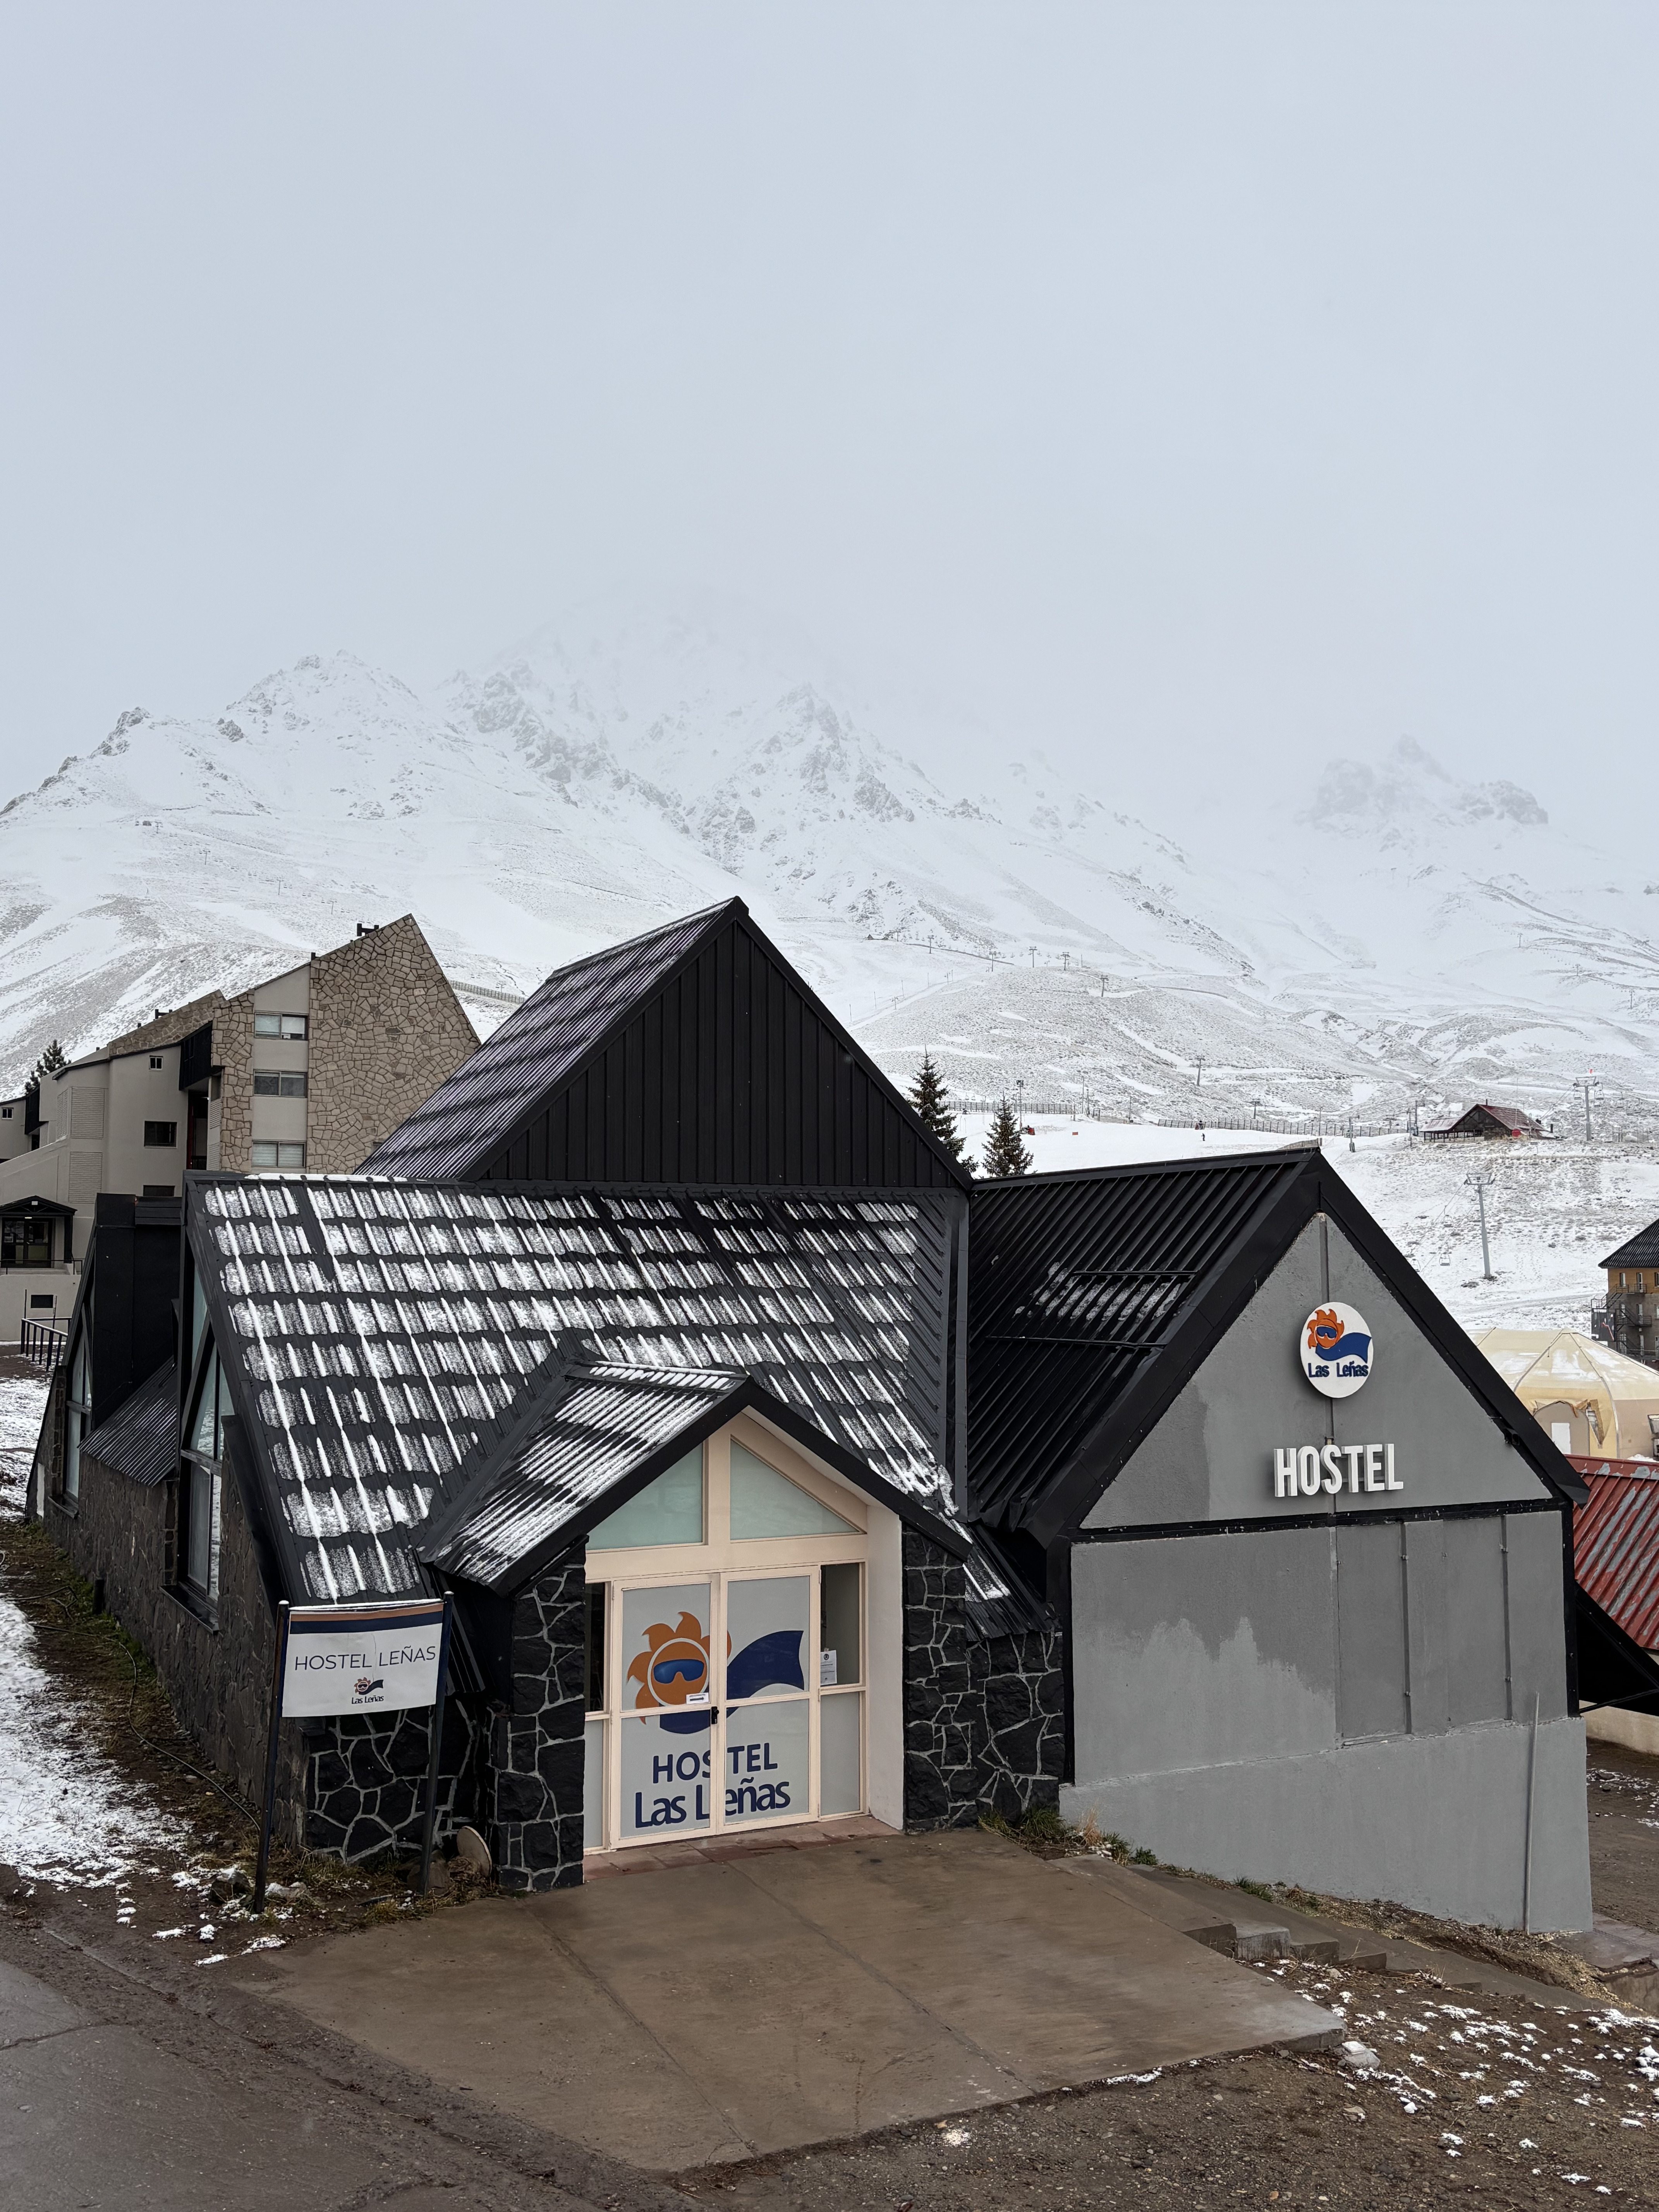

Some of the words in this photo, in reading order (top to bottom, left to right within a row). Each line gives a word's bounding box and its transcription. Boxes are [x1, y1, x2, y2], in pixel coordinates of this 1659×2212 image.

[1308, 1362, 1329, 1378] Las
[1336, 1360, 1369, 1377] Leñas
[1274, 1443, 1404, 1498] HOSTEL
[295, 1654, 372, 1671] HOSTEL
[379, 1645, 436, 1667] LEÑAS
[364, 1695, 384, 1703] Leñas
[635, 1791, 687, 1828] Las
[696, 1776, 791, 1820] Leñas
